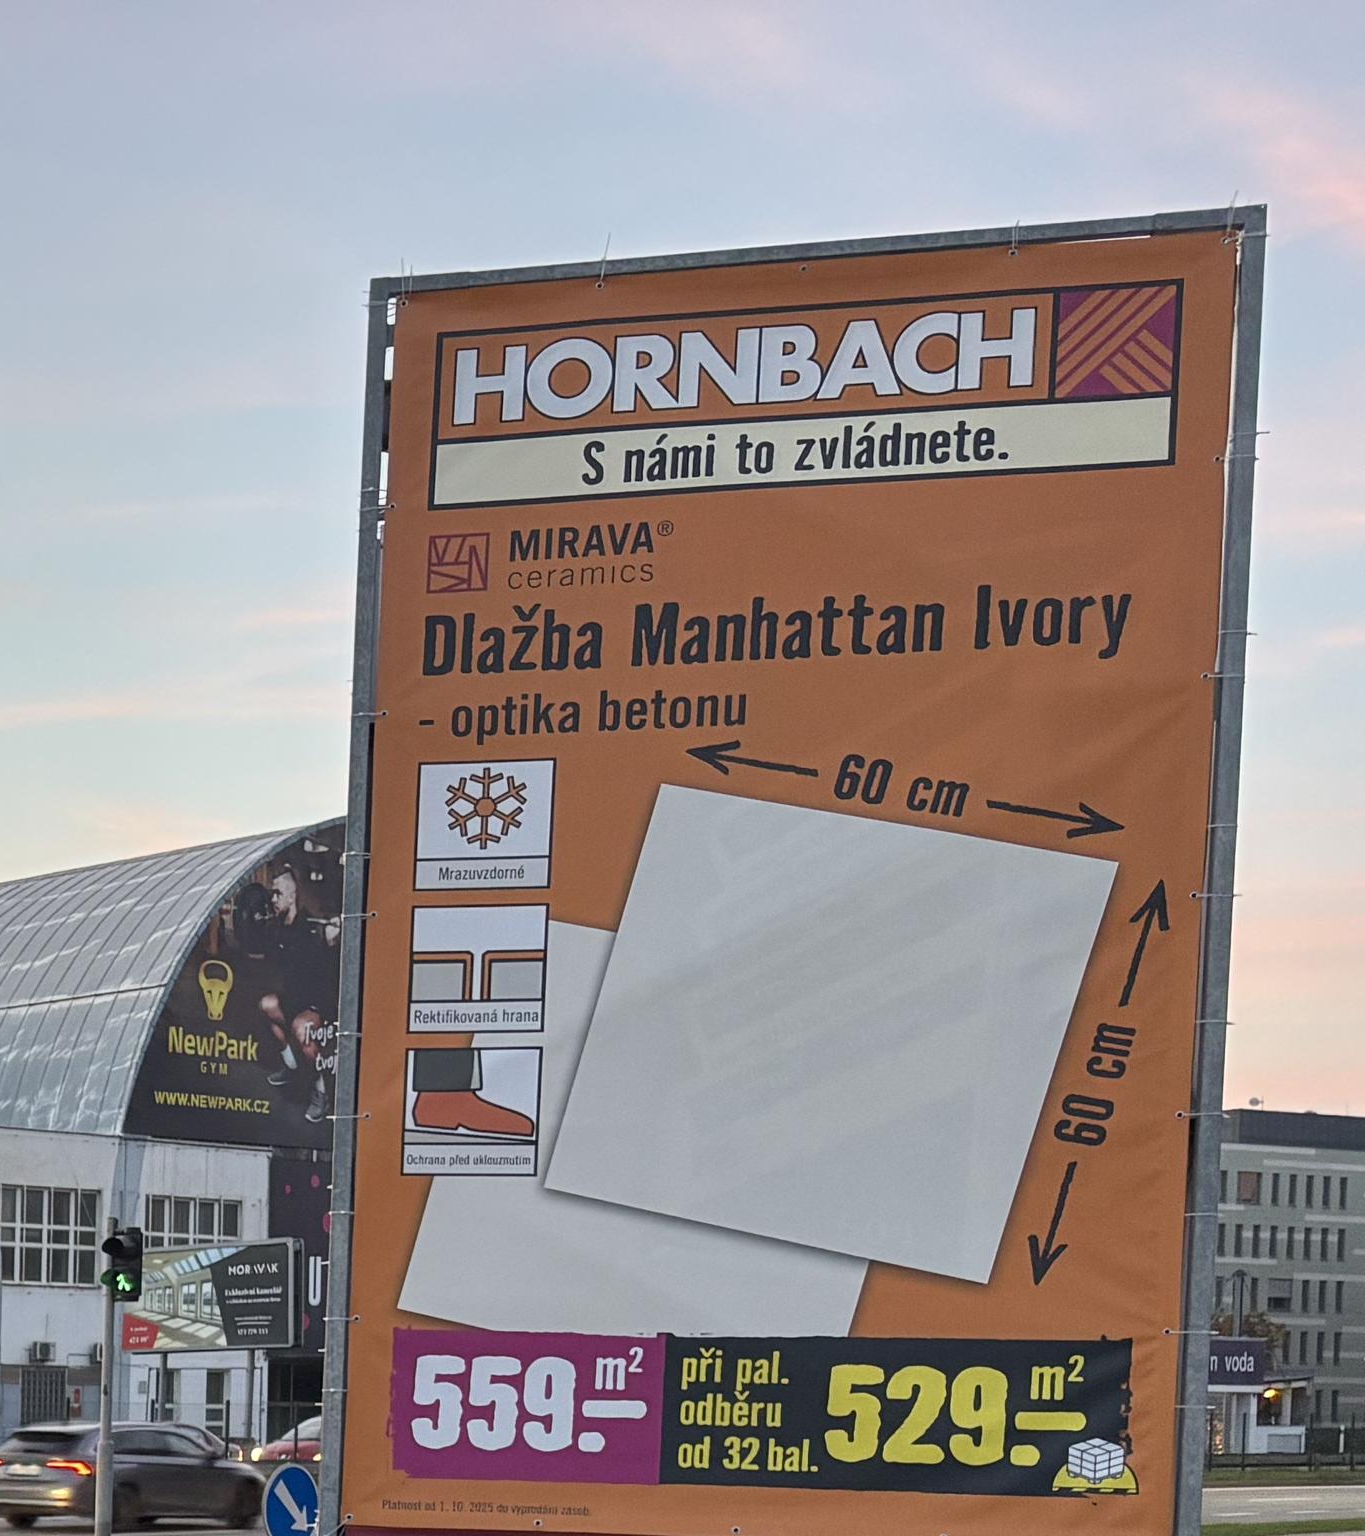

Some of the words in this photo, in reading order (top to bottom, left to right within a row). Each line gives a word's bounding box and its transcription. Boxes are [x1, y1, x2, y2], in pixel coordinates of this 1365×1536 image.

[452, 307, 1038, 427] HORNBACH
[583, 439, 607, 487] S
[625, 432, 717, 483] námi
[736, 433, 774, 475] to
[794, 420, 1010, 472] zvládnete.
[507, 560, 655, 590] ceramics
[422, 604, 603, 677] Dlažba
[631, 595, 944, 667] Manhattan
[974, 584, 1133, 659] Ivory
[450, 694, 582, 745] optika
[599, 690, 747, 734] betonu
[834, 753, 893, 805] 60
[906, 776, 970, 817] cm
[438, 865, 525, 882] Mrazuvzdorné
[414, 1008, 498, 1024] Rektifikovaná
[502, 1008, 539, 1024] hrana
[168, 1026, 259, 1061] NewPark
[200, 1061, 228, 1075] GYM
[1053, 1093, 1115, 1147] 60
[1086, 1022, 1136, 1079] cm
[154, 1090, 270, 1114] WWW.NEWPARK.CZ
[681, 1347, 726, 1386] při
[736, 1352, 789, 1389] pal.
[1224, 1351, 1254, 1372] voda
[679, 1391, 782, 1429] odběru
[678, 1438, 711, 1470] od
[723, 1438, 760, 1472] 32
[767, 1438, 819, 1474] bal.
